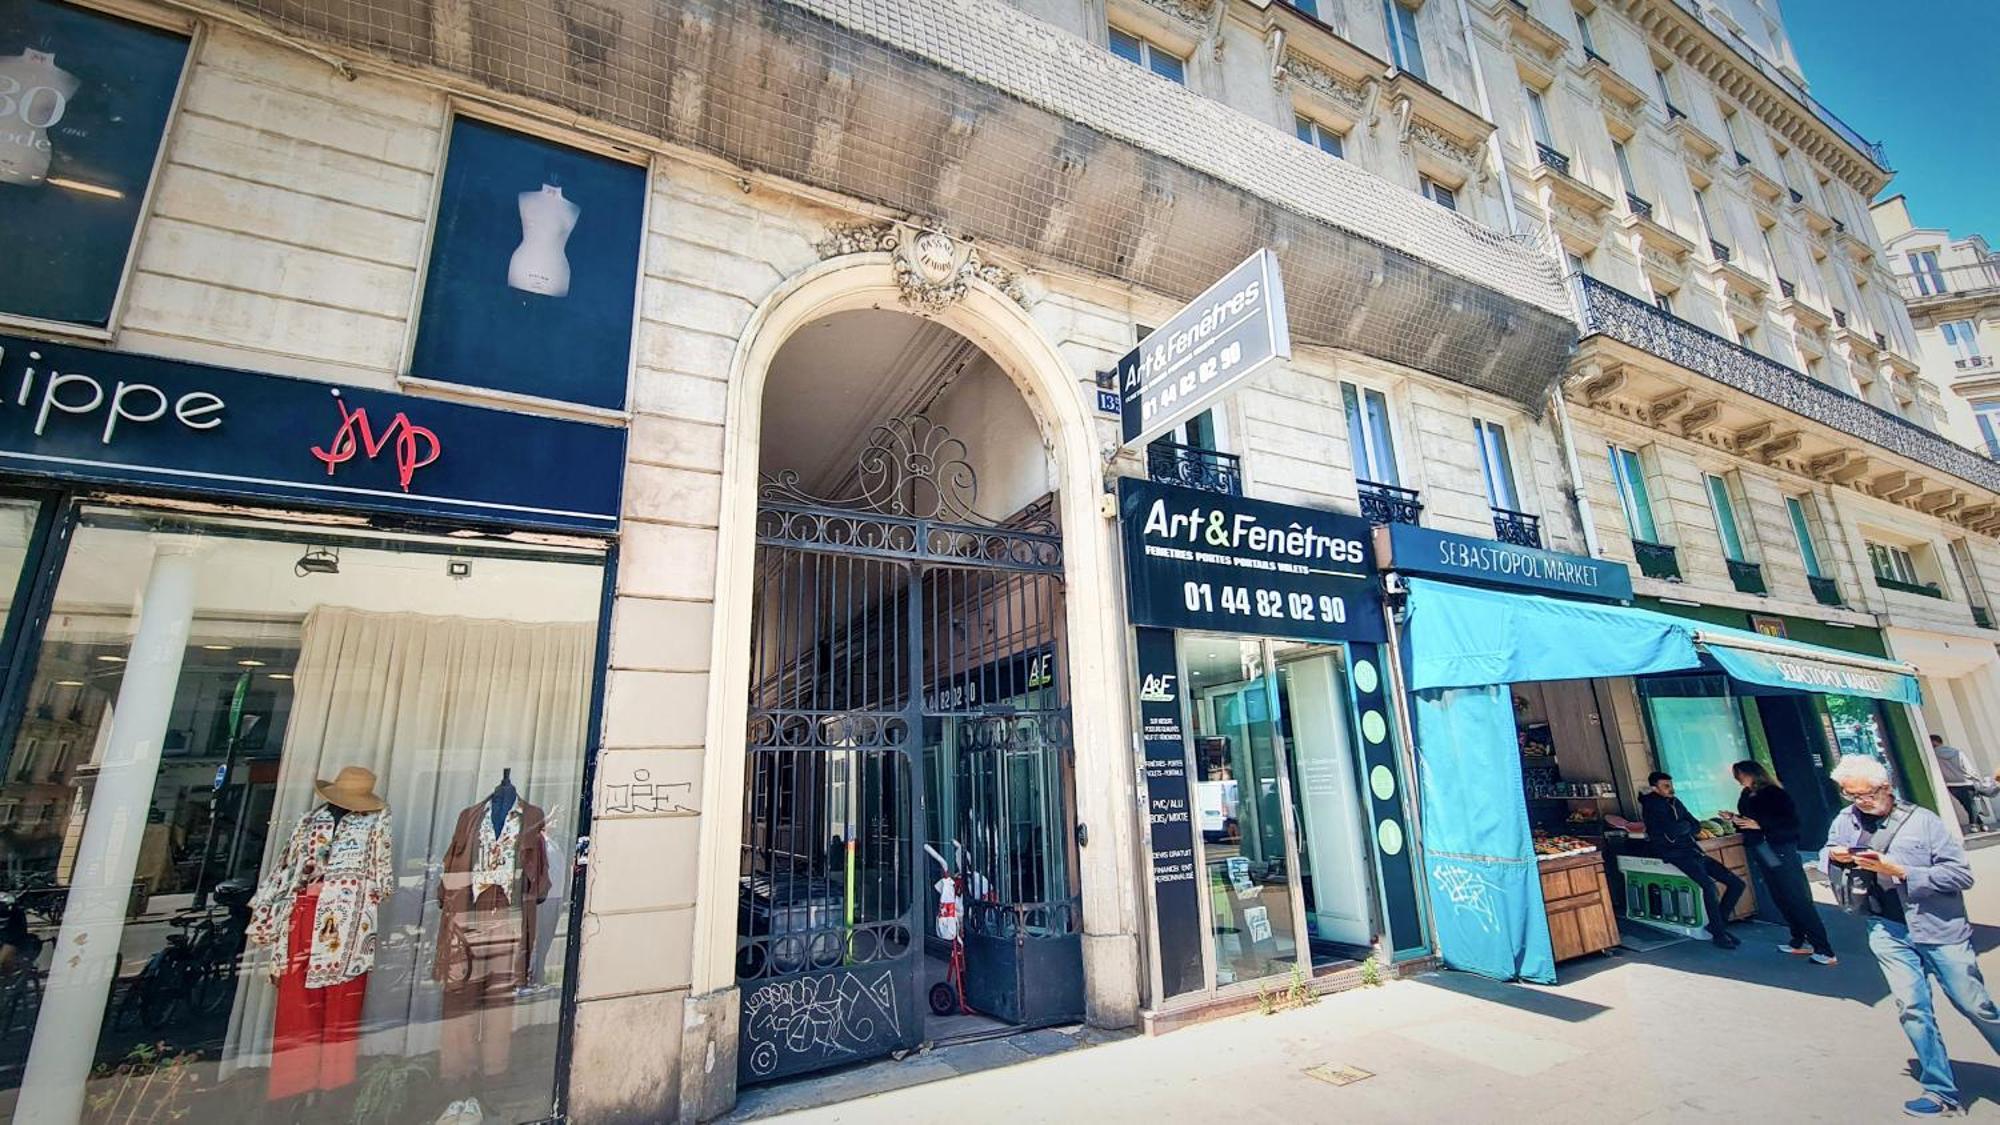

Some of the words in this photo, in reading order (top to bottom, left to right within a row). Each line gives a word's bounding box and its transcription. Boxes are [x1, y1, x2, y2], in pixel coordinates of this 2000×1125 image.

[1125, 280, 1260, 393] Art&Fenêtres
[0, 346, 225, 445] ippe
[1144, 498, 1364, 563] Art&Fenêtres
[1196, 552, 1232, 566] PORTES
[1233, 557, 1277, 572] PORTAILS
[1278, 562, 1310, 575] VOLETS
[1439, 540, 1541, 579] SEBASTOPOL
[1543, 558, 1598, 587] MARKET
[1184, 581, 1213, 613] 01
[1221, 585, 1250, 616] 44
[1256, 589, 1284, 618] 82
[1288, 592, 1315, 621] 02
[1320, 595, 1347, 624] 90
